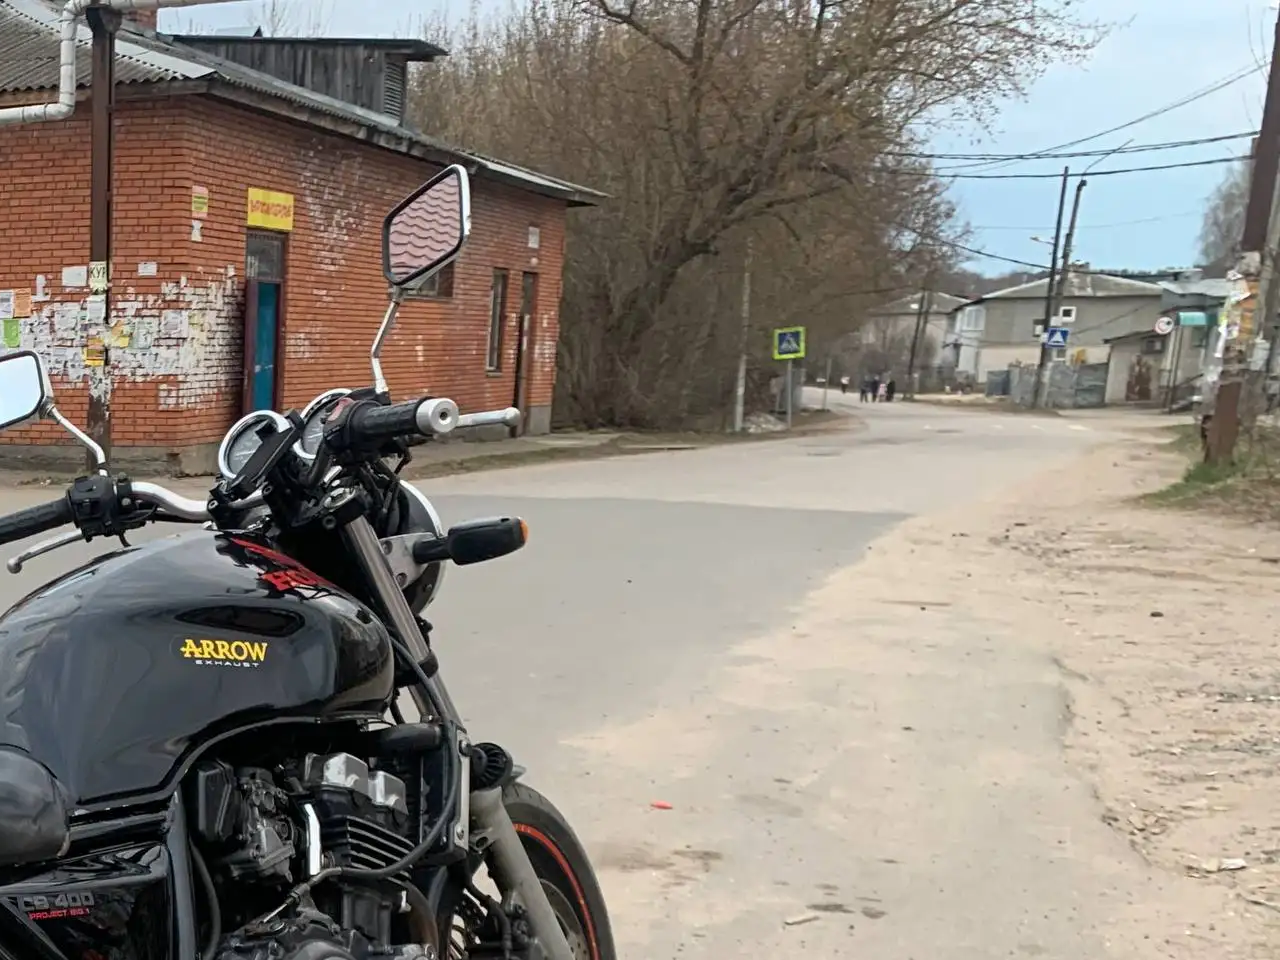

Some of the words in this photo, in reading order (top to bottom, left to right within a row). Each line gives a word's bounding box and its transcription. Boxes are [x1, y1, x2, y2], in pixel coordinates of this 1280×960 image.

[180, 638, 268, 662] ARROW
[195, 659, 260, 668] EXHAUST
[19, 895, 50, 912] CB
[54, 891, 95, 908] 400
[29, 909, 68, 920] PROJECT
